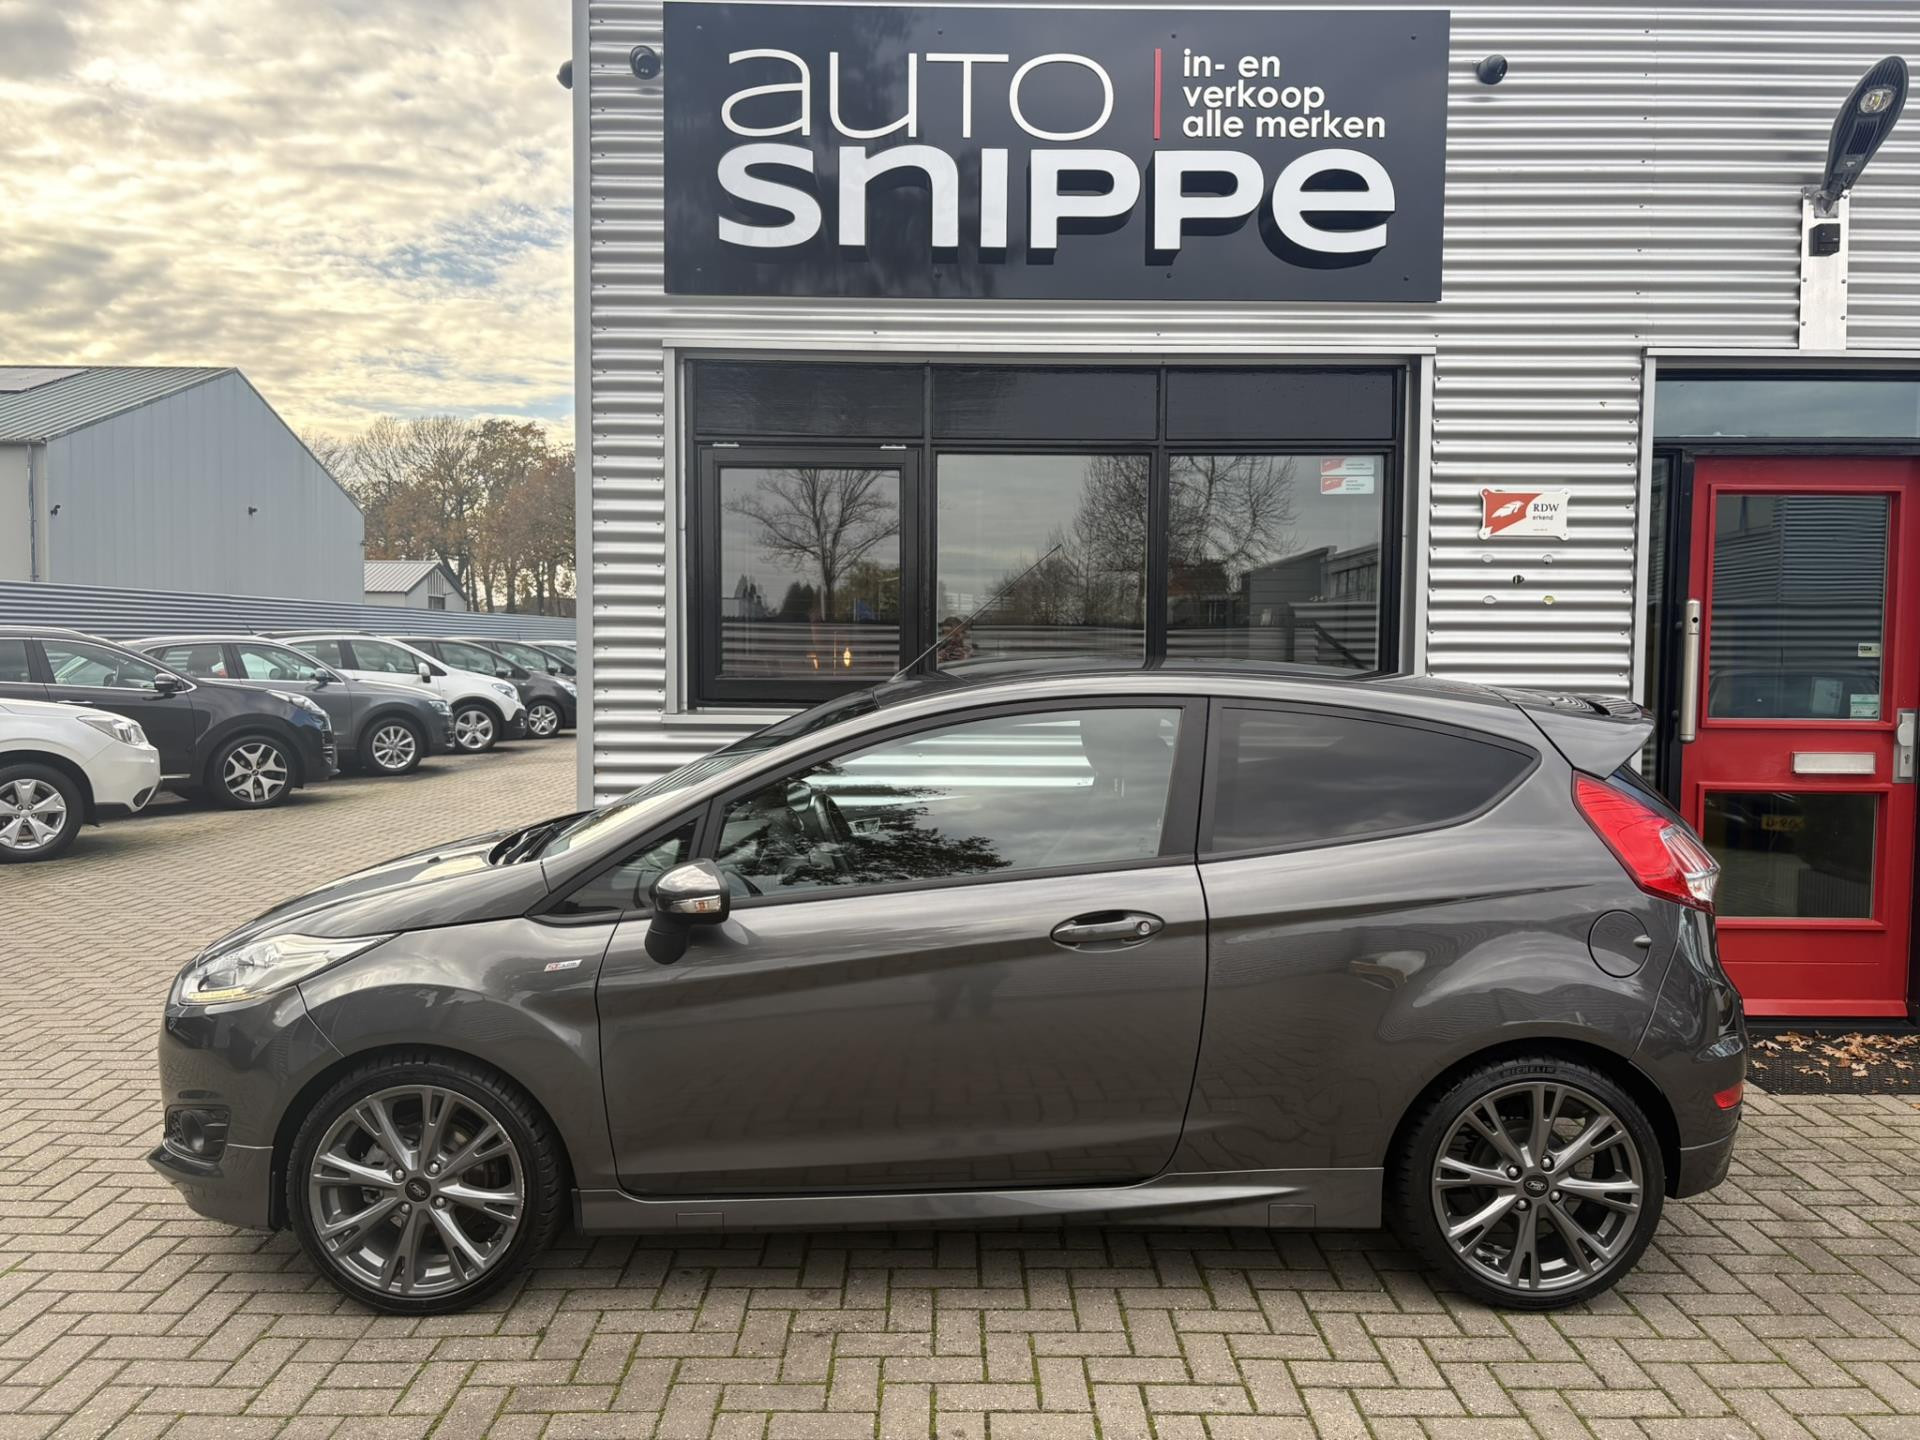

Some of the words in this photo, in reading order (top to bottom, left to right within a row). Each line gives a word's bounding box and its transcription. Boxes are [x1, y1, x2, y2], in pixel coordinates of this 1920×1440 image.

[1183, 48, 1226, 77] in-
[1238, 55, 1281, 78] en
[1182, 79, 1326, 115] verkoop
[1182, 109, 1244, 138] alle
[1256, 110, 1386, 138] merken
[1533, 503, 1559, 512] RDW
